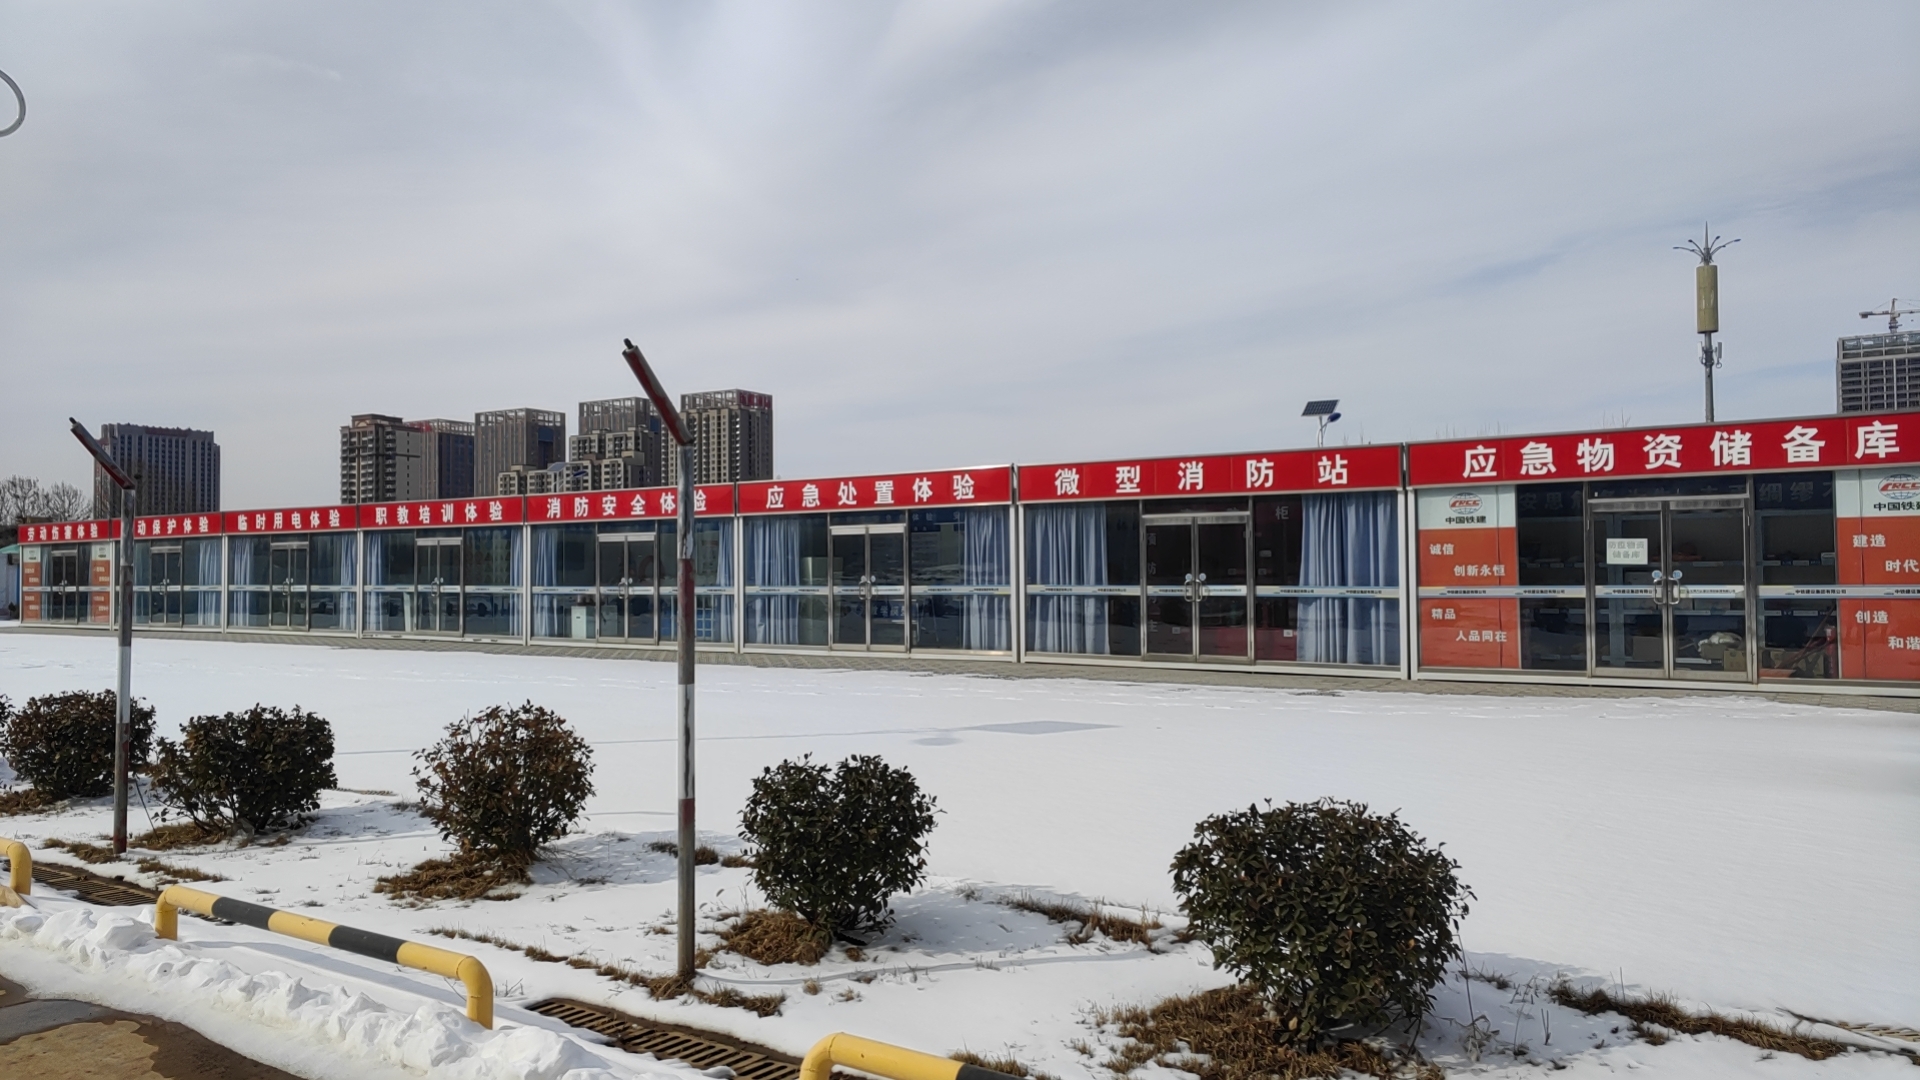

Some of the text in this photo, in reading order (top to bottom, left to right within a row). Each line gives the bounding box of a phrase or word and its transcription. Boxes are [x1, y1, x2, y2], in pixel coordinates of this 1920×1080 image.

[1462, 420, 1900, 479] 应急物资储备库
[1053, 453, 1349, 496] 微型消防站
[765, 473, 976, 510] 应急处置体验
[546, 489, 707, 519] 消防安全体验
[237, 508, 341, 531] 临时用电体验
[375, 500, 503, 525] 职教培训体验
[1445, 515, 1487, 525] 中国铁建
[27, 523, 98, 541] 劳动伤害体验
[137, 516, 209, 536] 动保护体验
[1853, 534, 1886, 548] 建造
[1429, 543, 1455, 555] 诚信
[1453, 563, 1506, 578] 创新永恒
[1885, 559, 1920, 573] 时代
[1431, 607, 1456, 620] 精品
[1855, 610, 1889, 624] 创造
[1455, 630, 1507, 643] 人品同在
[1888, 636, 1920, 650] 和谐
